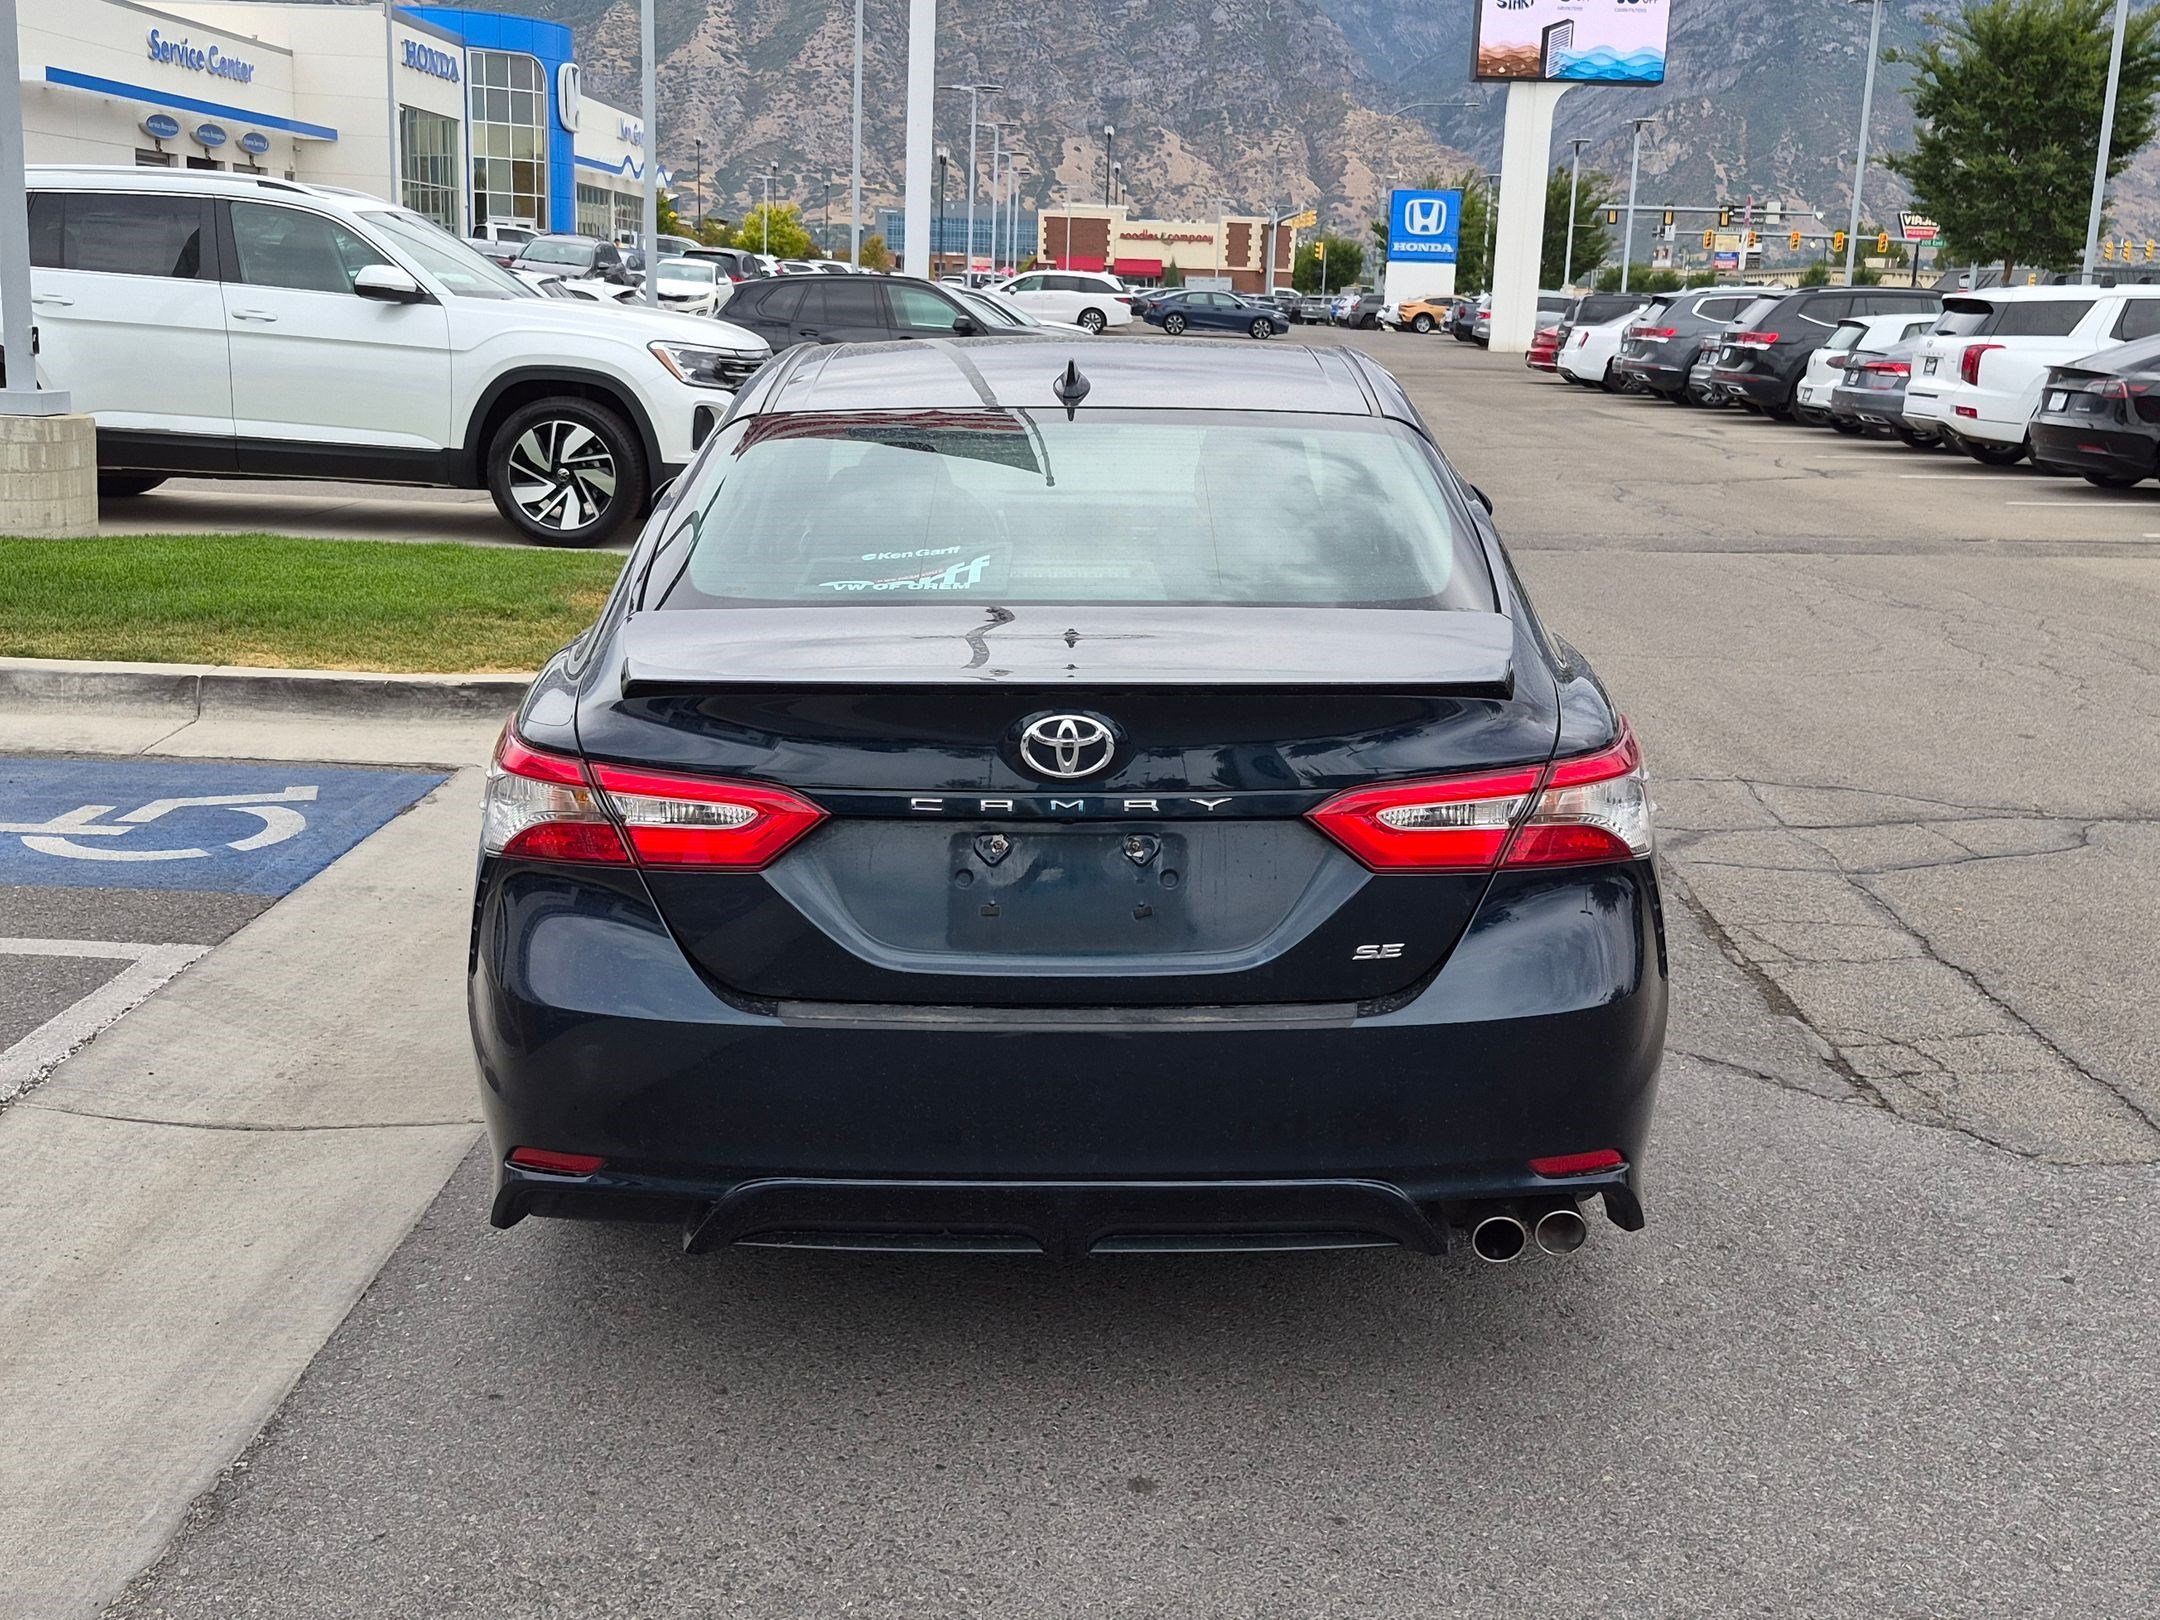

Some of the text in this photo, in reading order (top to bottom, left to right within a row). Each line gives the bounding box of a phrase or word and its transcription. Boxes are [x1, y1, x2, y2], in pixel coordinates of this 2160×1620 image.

[148, 29, 254, 83] Service Center
[401, 39, 460, 82] HONDA
[1120, 229, 1160, 241] noodles
[1168, 233, 1213, 245] company
[1393, 242, 1454, 253] HONDA
[878, 546, 961, 560] Ken Garff
[872, 582, 901, 591] OF
[911, 798, 1232, 812] CAMRY
[1352, 943, 1405, 960] SE
